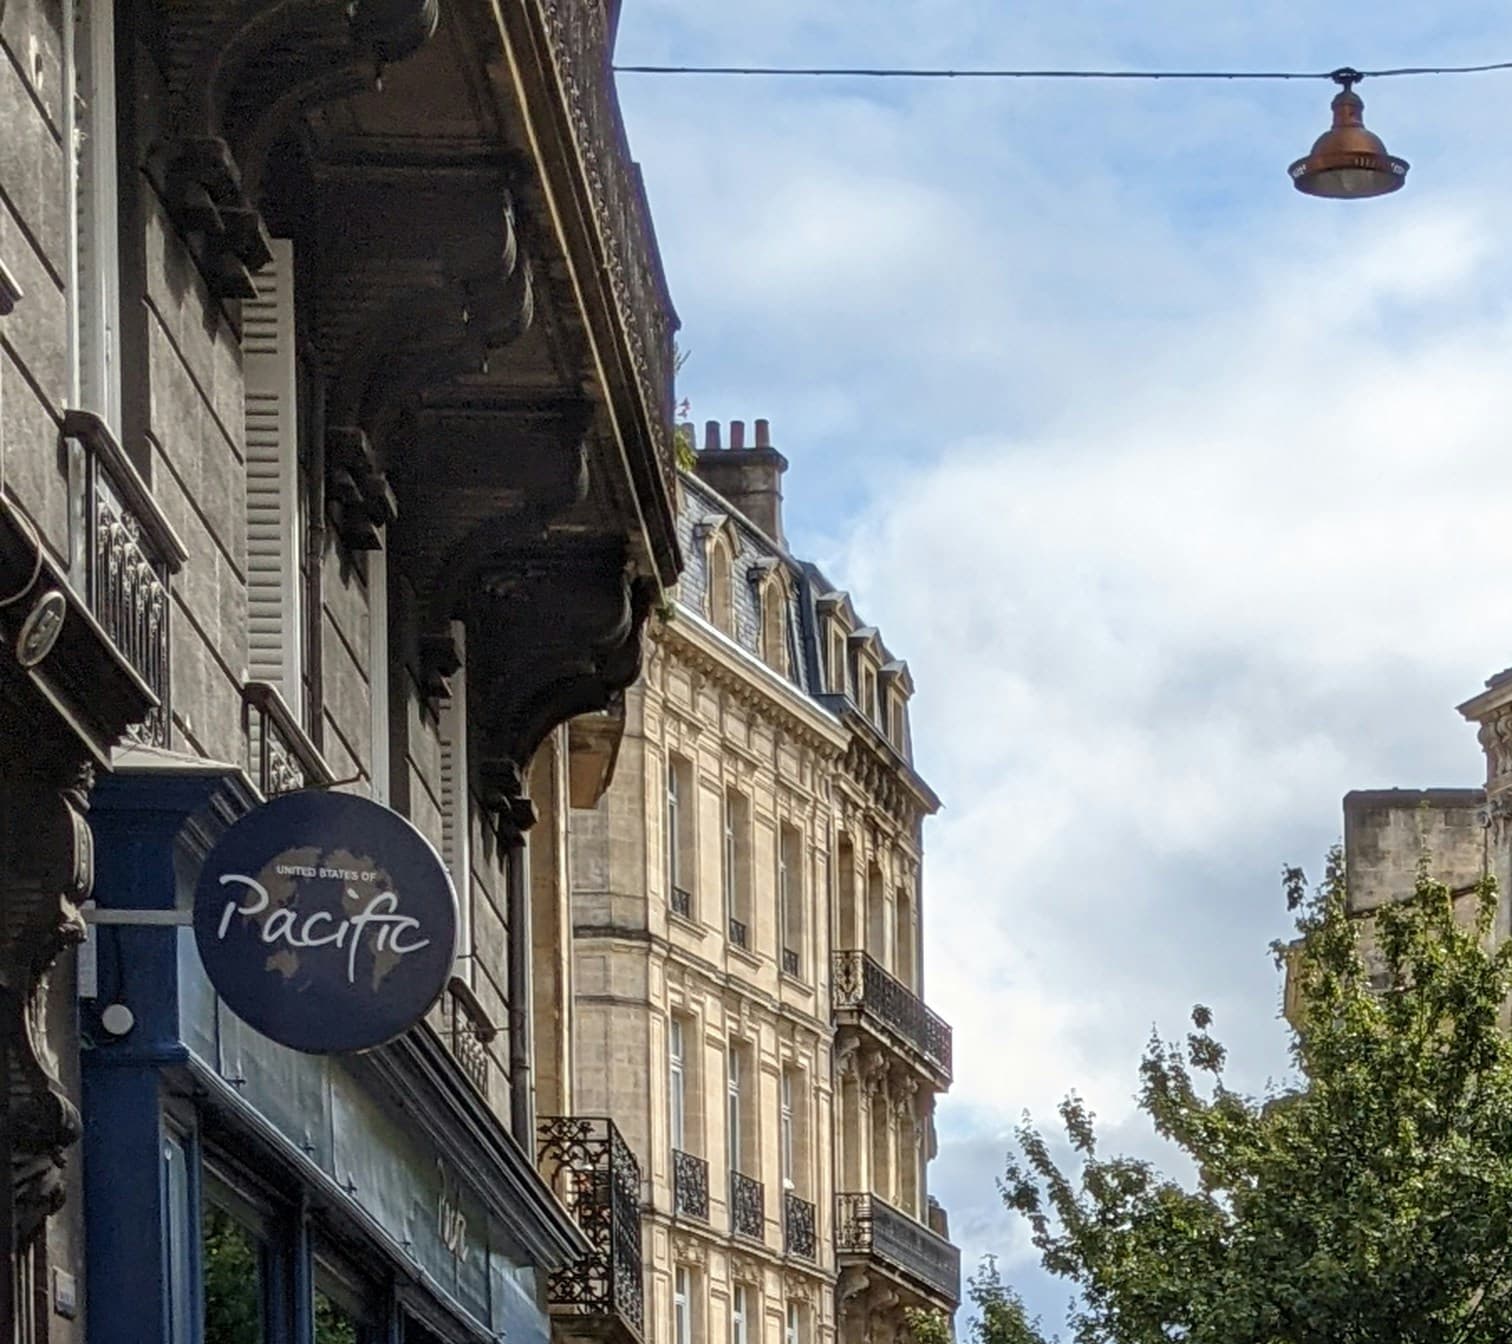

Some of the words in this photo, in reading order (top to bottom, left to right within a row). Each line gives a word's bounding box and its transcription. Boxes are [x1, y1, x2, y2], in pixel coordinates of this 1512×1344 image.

[276, 864, 316, 878] UNITED
[319, 867, 358, 881] STATES
[360, 871, 377, 881] OF
[217, 873, 431, 983] Pacific
